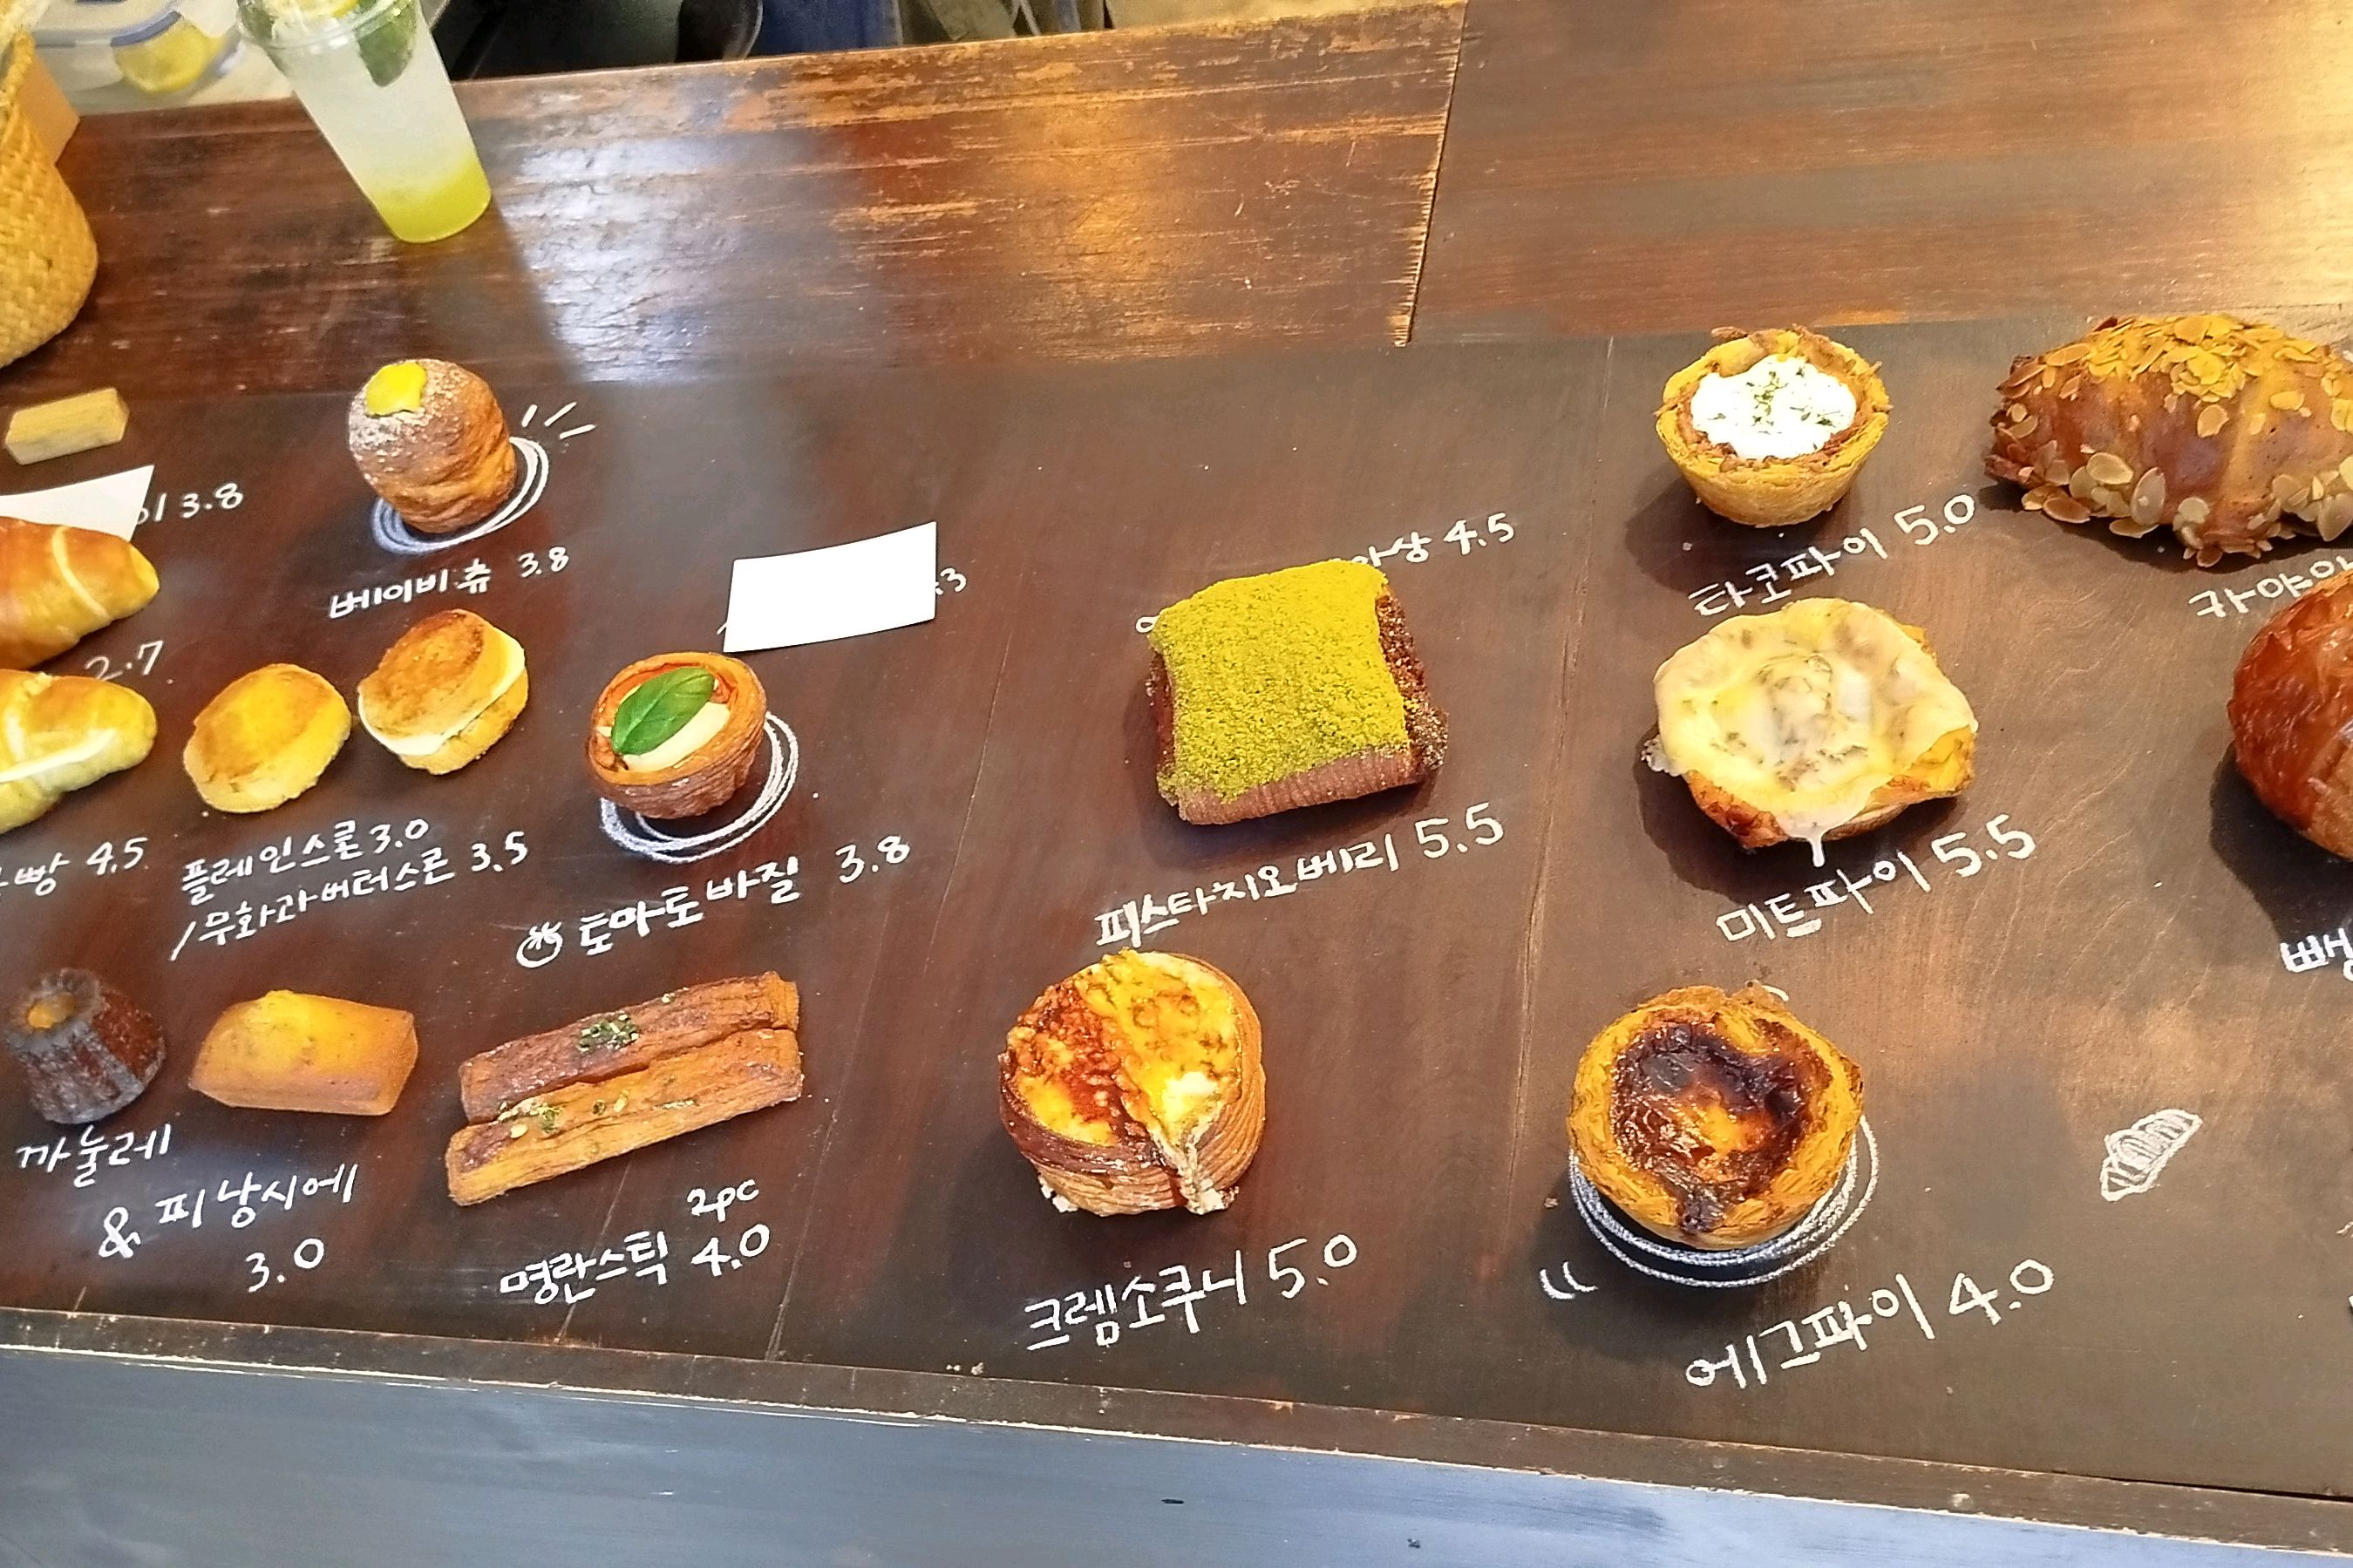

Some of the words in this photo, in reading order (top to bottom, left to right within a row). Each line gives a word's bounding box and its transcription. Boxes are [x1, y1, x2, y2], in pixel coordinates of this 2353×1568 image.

[182, 483, 243, 519] 3.8
[1443, 512, 1514, 555] 4.5
[1688, 527, 1888, 616] 타코파이
[1894, 494, 1975, 546] 5.0
[518, 546, 569, 578] 3.8
[85, 640, 164, 681] 2.7
[369, 818, 430, 854] 3.0
[471, 831, 528, 872] 3.5
[1414, 802, 1505, 859] 5.5
[86, 837, 148, 876] 4.5
[835, 835, 910, 883] 3.8
[1716, 849, 1932, 941] 미트파이
[1932, 814, 2037, 878] 5.5
[16, 1123, 172, 1188] 까눌레
[686, 1178, 759, 1223] 2pc
[98, 1206, 141, 1259] &
[245, 1238, 325, 1293] 3.0
[500, 1230, 669, 1305] 명란스틱
[690, 1224, 770, 1277] 4.0
[1268, 1234, 1357, 1299] 5.0
[1685, 1274, 1935, 1389] 에그파이
[1948, 1259, 2055, 1326] 4.0
